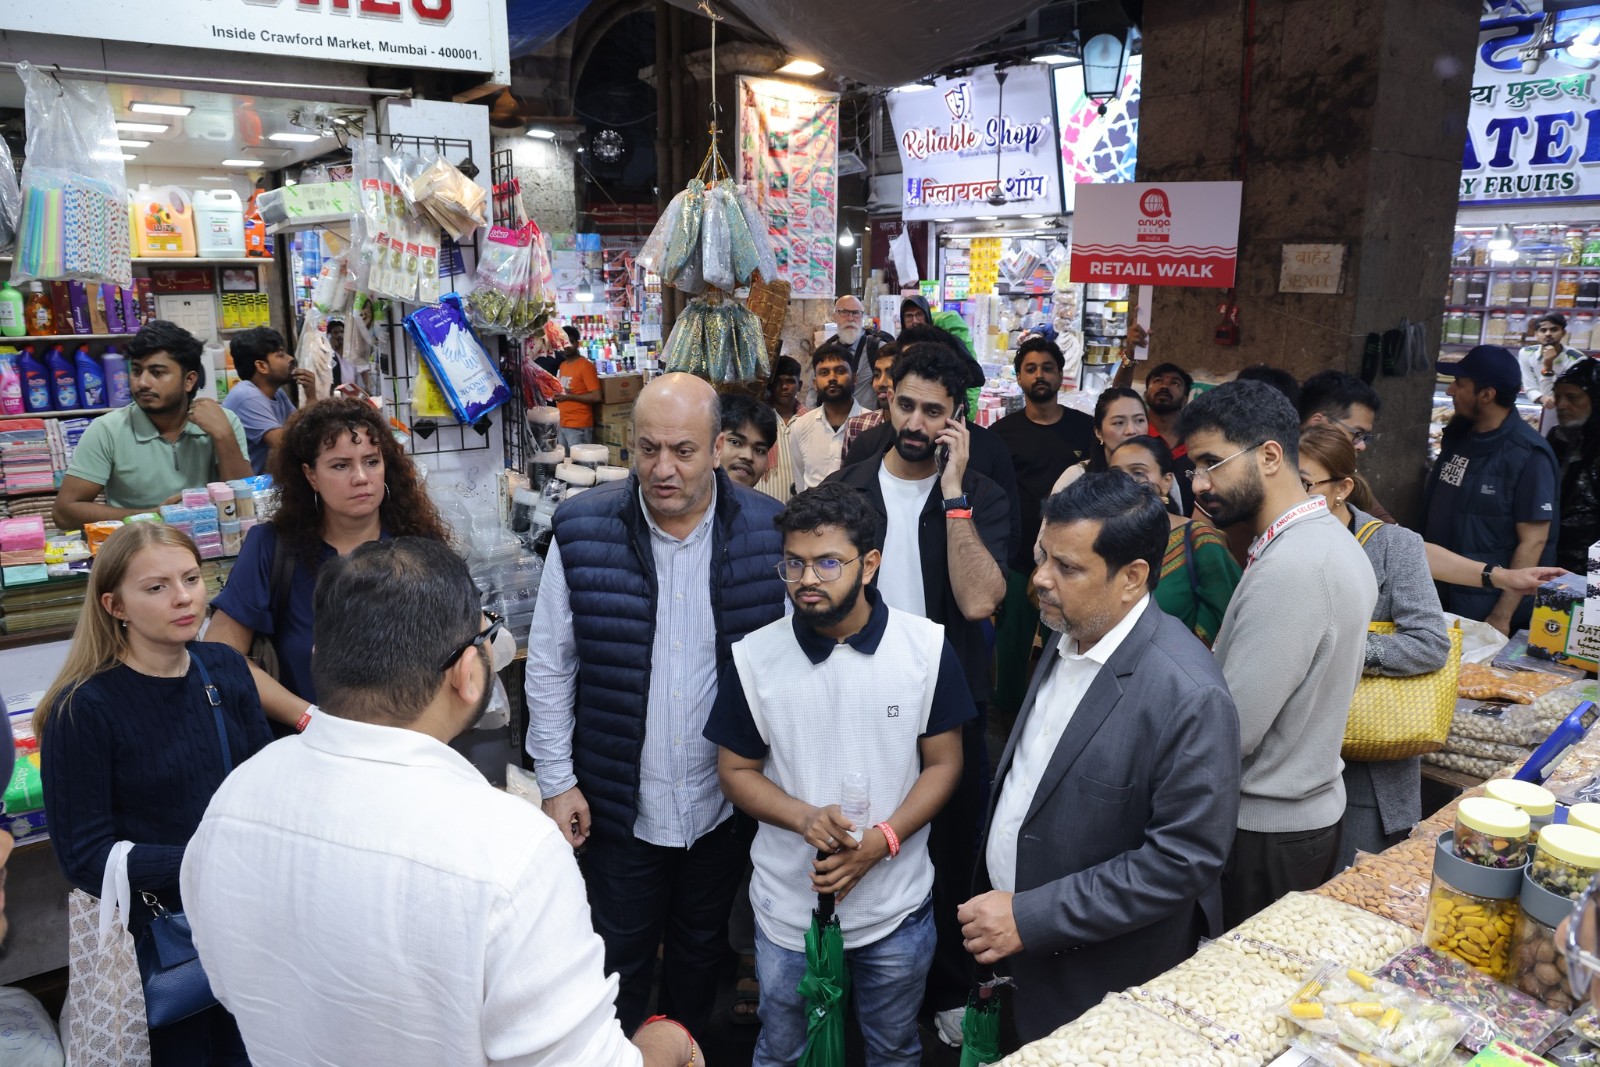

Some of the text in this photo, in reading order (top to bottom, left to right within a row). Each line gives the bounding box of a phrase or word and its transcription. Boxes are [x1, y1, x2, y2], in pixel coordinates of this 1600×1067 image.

[212, 25, 256, 41] Inside
[260, 29, 323, 47] Crawford
[327, 36, 375, 52] Market,
[378, 41, 427, 56] Mumbai
[438, 46, 482, 61] 400001.
[903, 118, 1042, 159] Reliable Shop
[1006, 169, 1044, 196] शॉप
[1484, 172, 1574, 193] FRUITS
[1138, 219, 1171, 228] anuga
[1296, 247, 1331, 265] बाहेर
[1090, 261, 1214, 278] RETAIL WALK
[1290, 275, 1329, 288] EXIT
[1450, 454, 1467, 467] THE
[1439, 470, 1459, 486] FACE
[1276, 512, 1297, 528] ANUGA
[1297, 502, 1318, 514] SELECT
[1577, 624, 1600, 637] DAT
